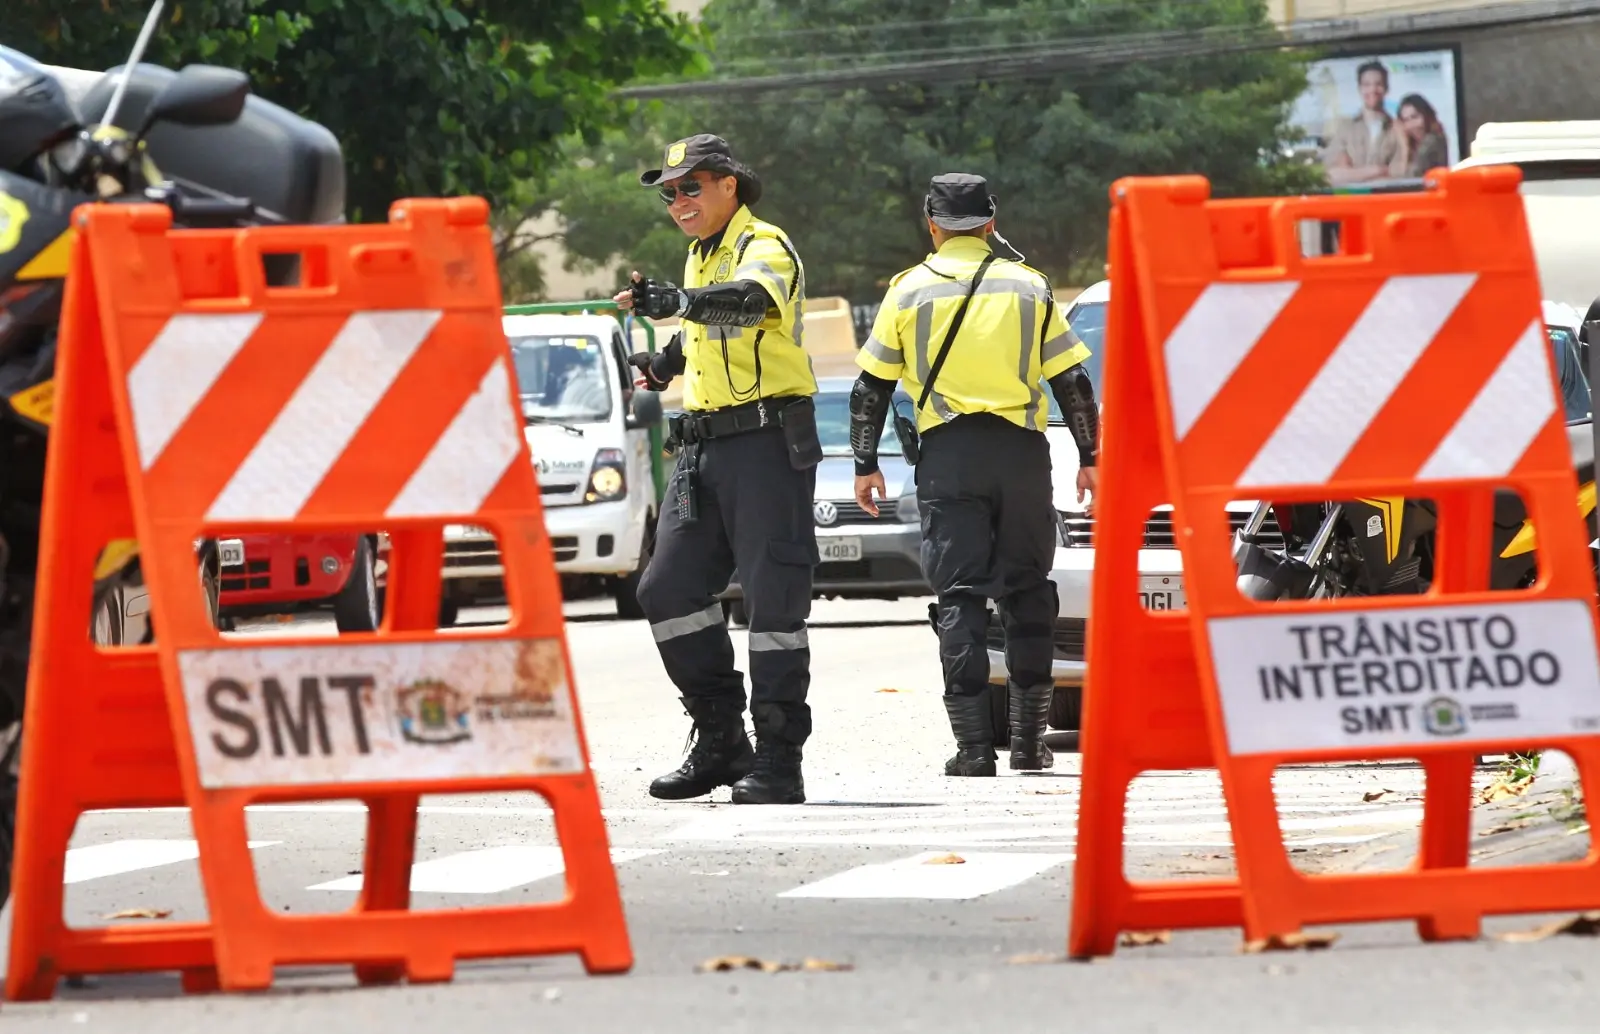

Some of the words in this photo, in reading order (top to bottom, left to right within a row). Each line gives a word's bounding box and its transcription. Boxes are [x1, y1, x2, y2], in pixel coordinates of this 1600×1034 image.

[1289, 614, 1517, 660] TRÂNSITO
[1259, 651, 1561, 701] INTERDITADO
[205, 676, 376, 759] SMT
[1341, 704, 1413, 734] SMT
